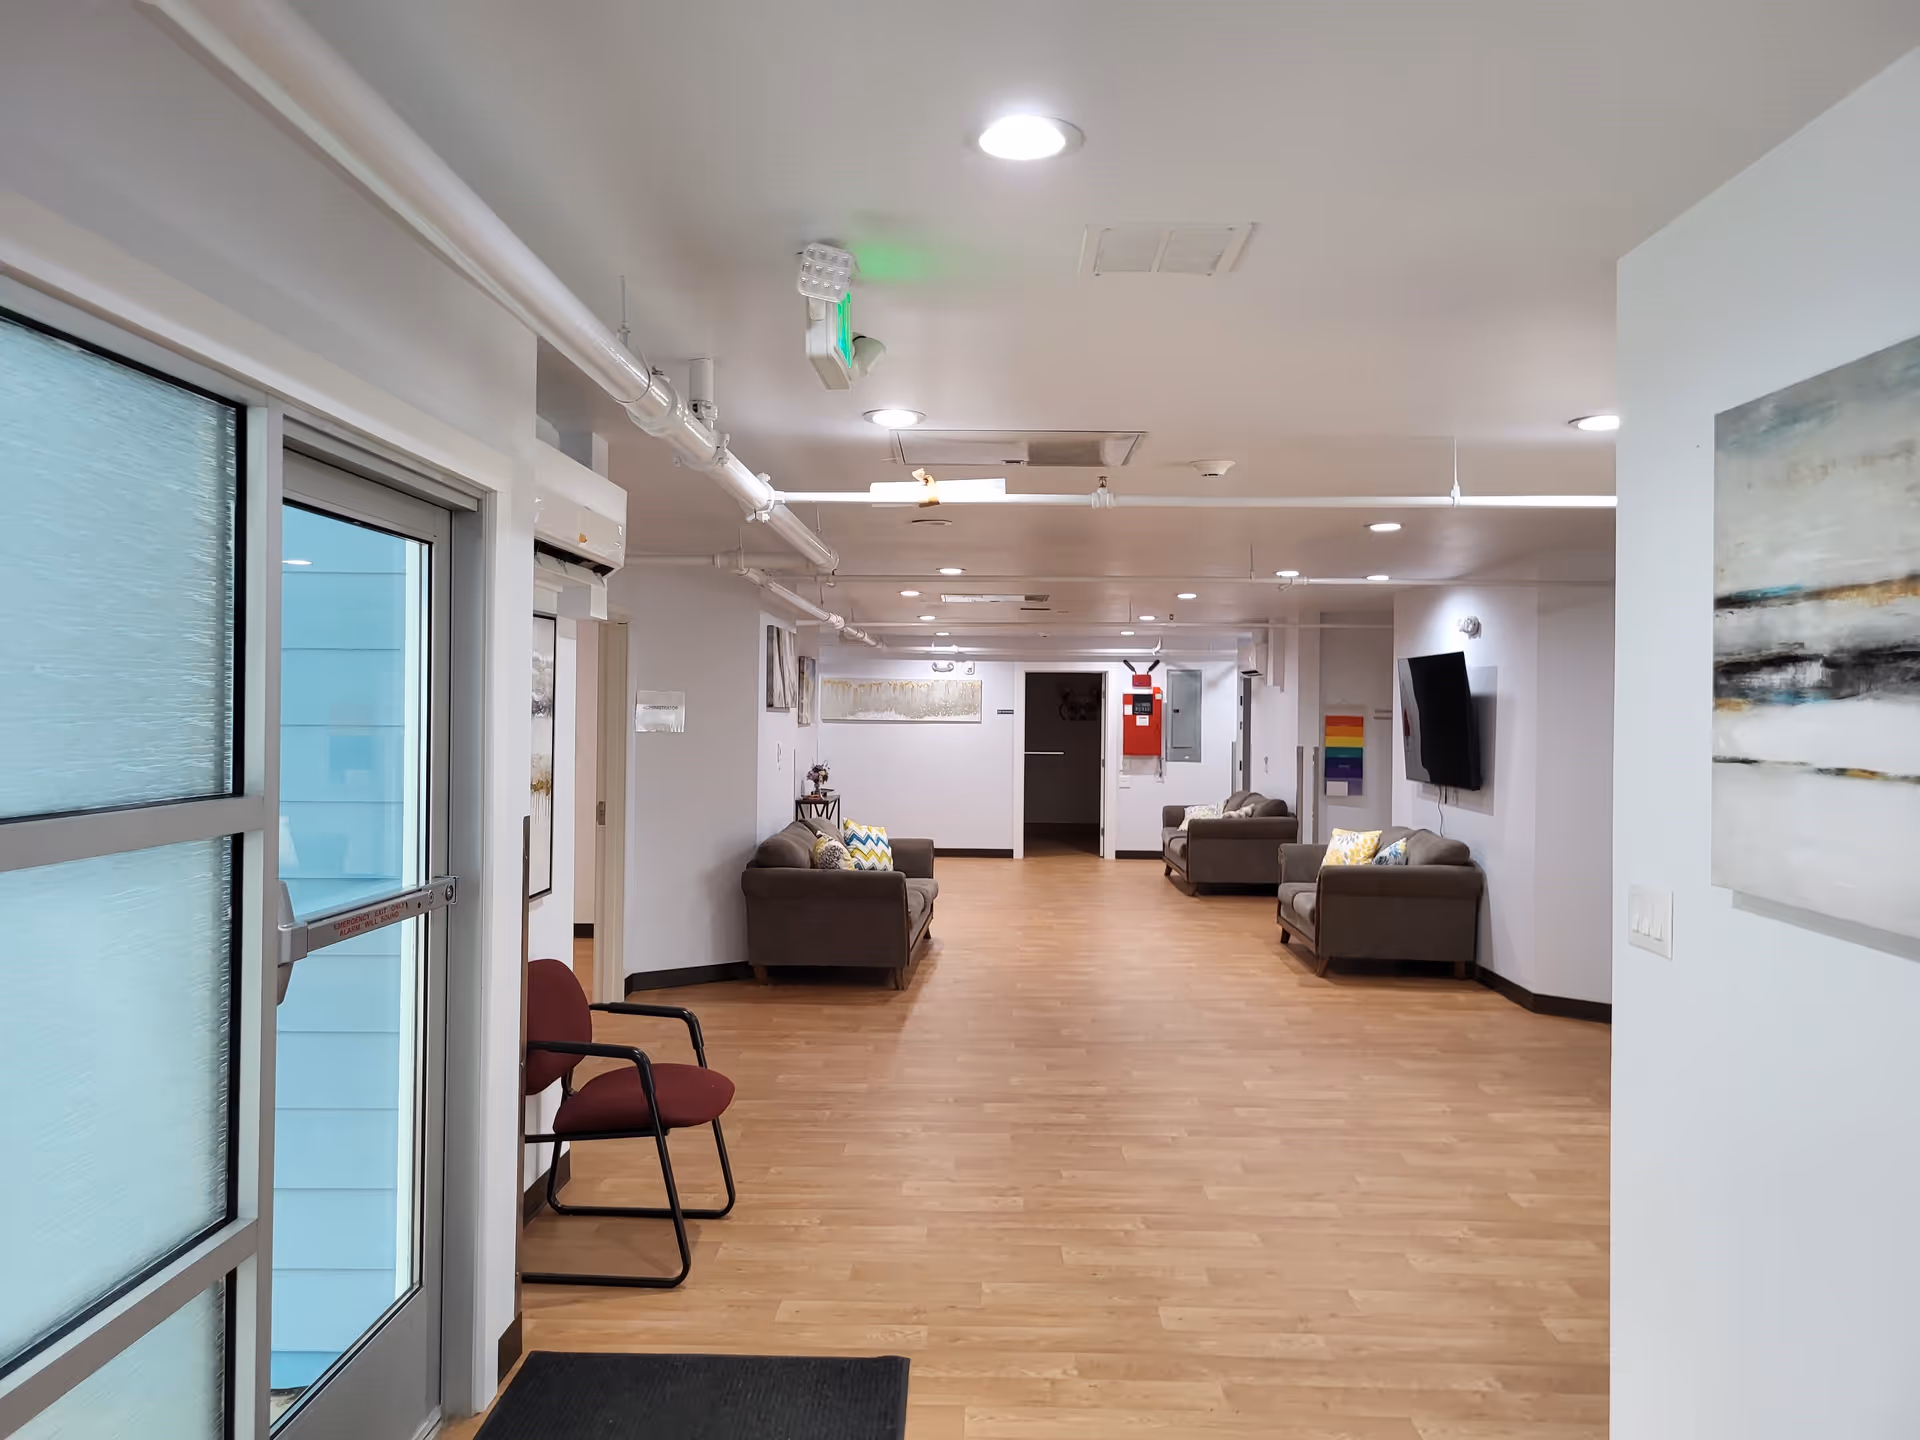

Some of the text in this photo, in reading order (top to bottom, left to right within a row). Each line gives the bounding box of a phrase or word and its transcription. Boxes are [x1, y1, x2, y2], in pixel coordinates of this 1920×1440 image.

[334, 914, 370, 930] EMERGENCY
[375, 907, 387, 917] EXIT
[340, 911, 399, 936] ALARM WILL SOUND
